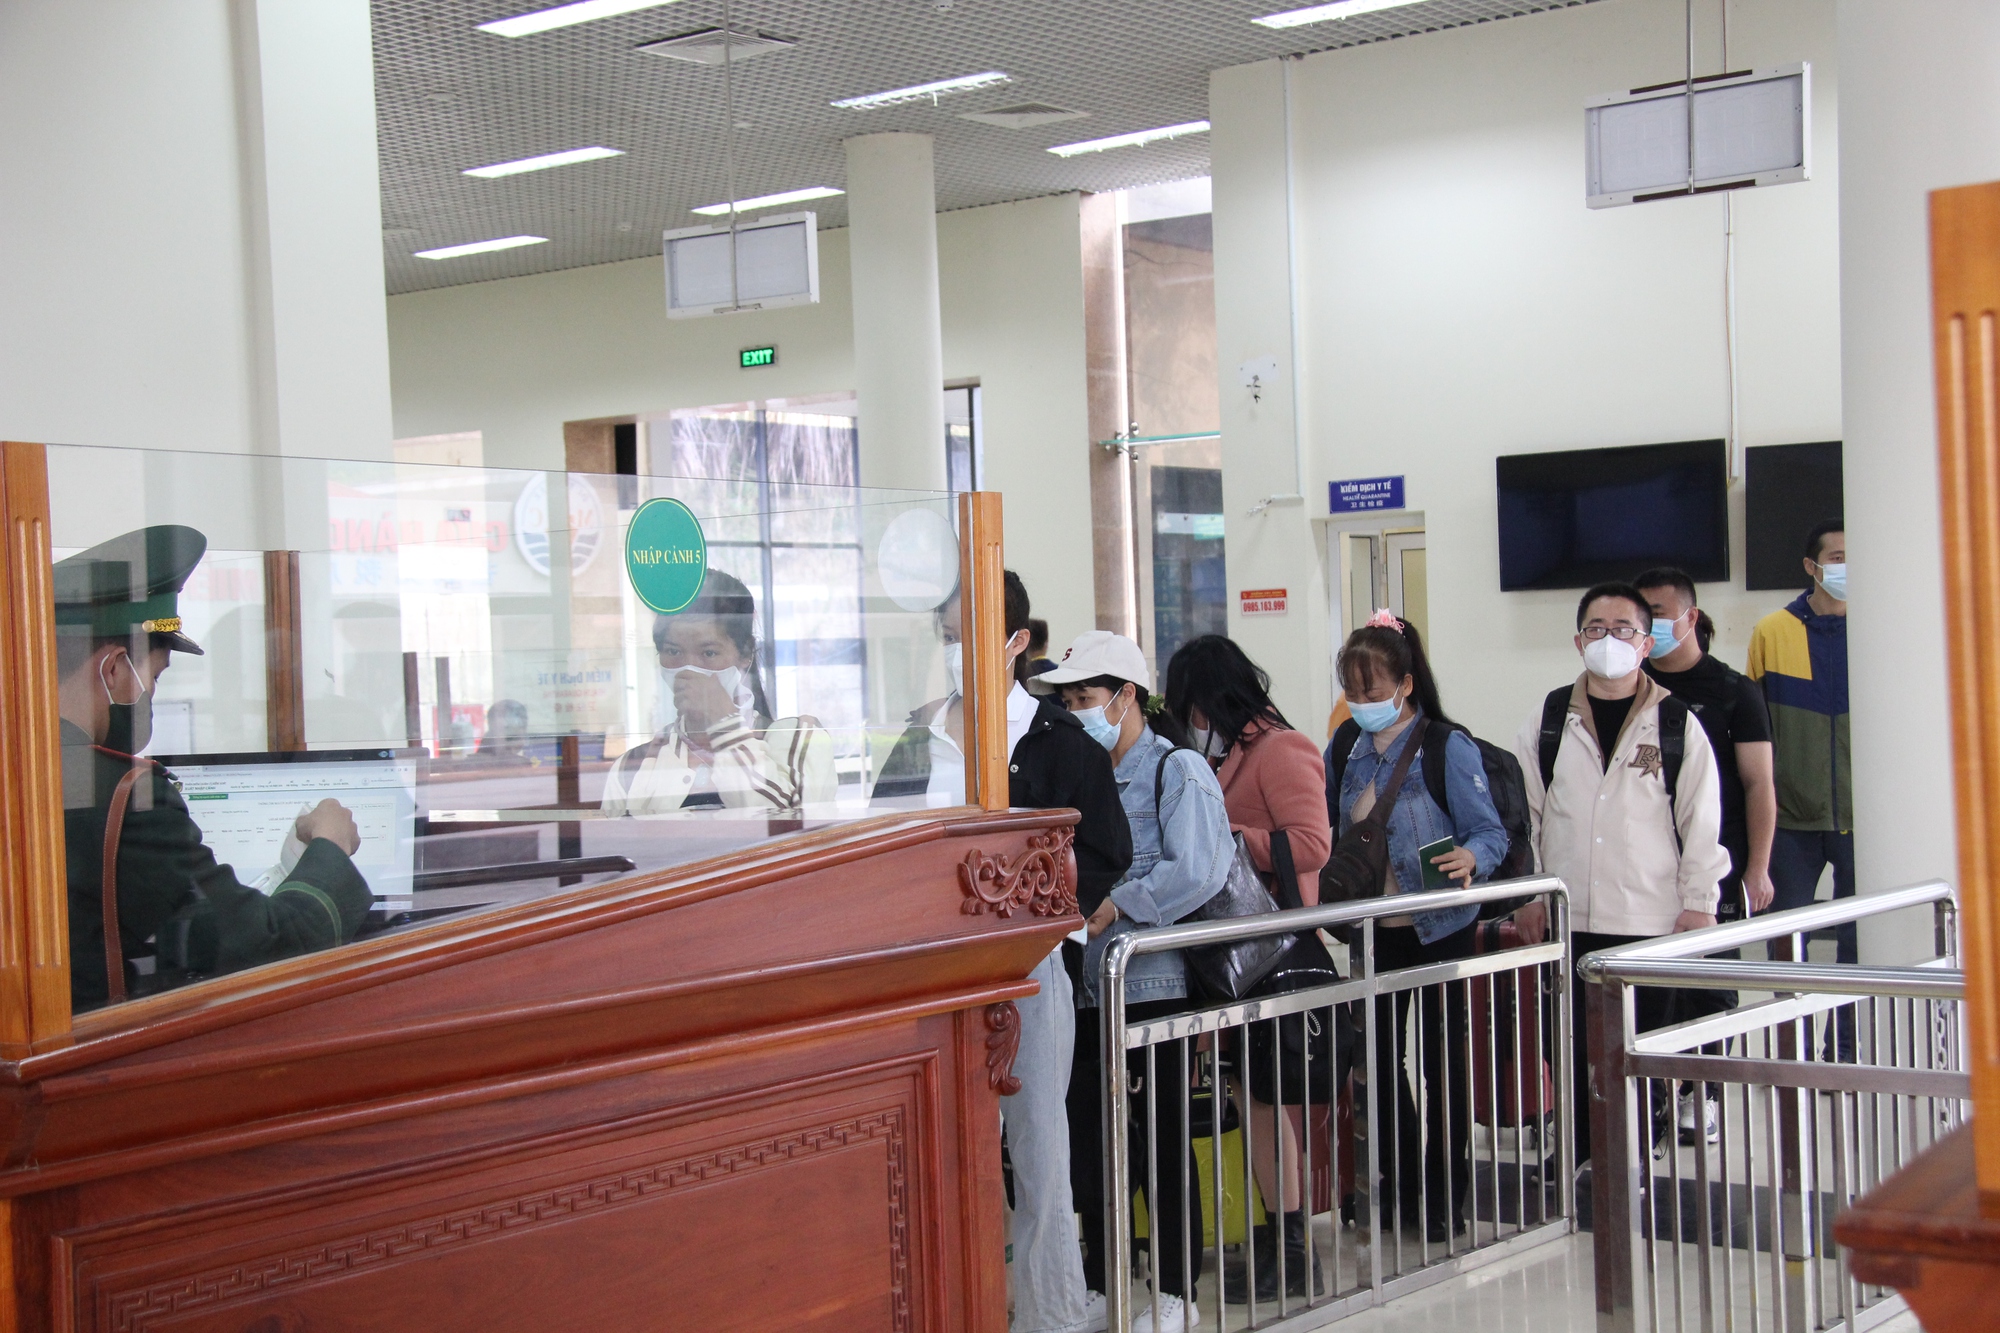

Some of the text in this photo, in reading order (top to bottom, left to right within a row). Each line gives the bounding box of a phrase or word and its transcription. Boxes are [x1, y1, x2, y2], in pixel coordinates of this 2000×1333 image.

[742, 348, 773, 367] EXIT
[1340, 479, 1392, 494] KIỂM DỊCH Y TẾ
[632, 545, 701, 568] NHẬP CẢNH 5
[1062, 647, 1073, 662] S
